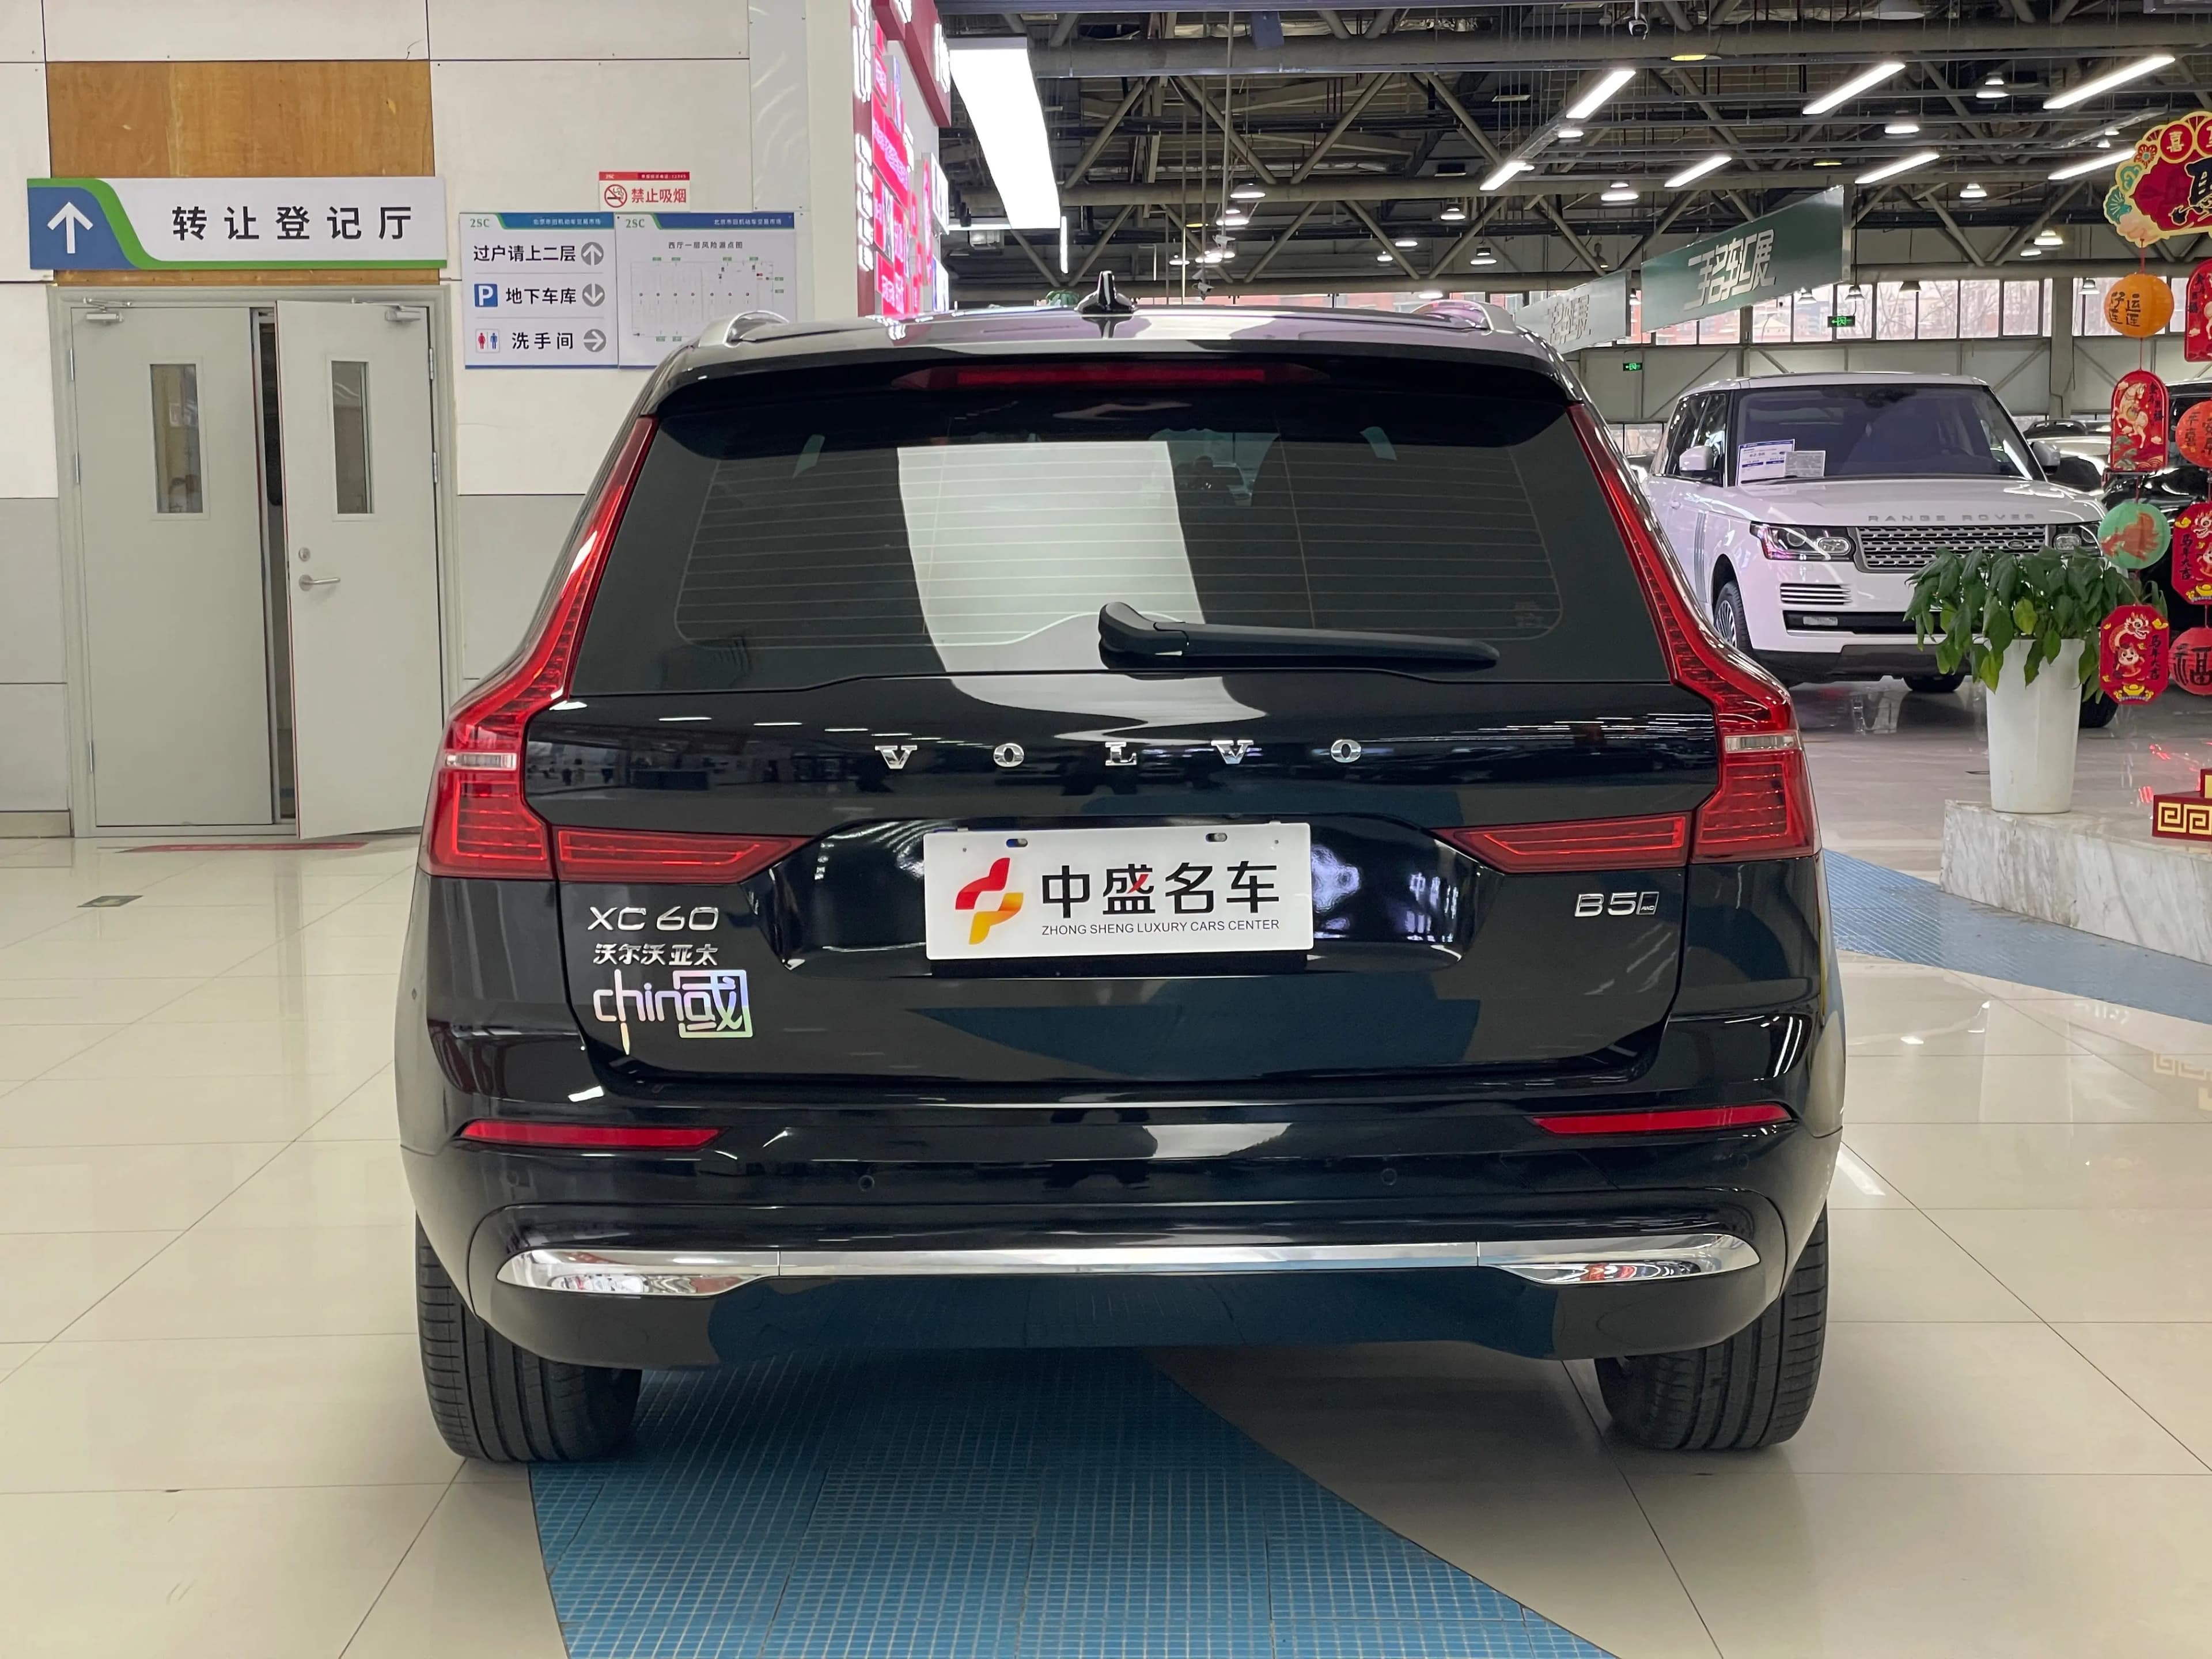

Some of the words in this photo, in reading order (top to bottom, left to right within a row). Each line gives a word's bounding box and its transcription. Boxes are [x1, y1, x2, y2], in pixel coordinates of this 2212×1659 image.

[631, 188, 686, 203] 禁止吸烟
[172, 206, 411, 241] 转让登记厅
[470, 218, 490, 228] 2SC
[626, 219, 645, 228] 2SC
[474, 245, 576, 262] 过户请上二层
[479, 285, 493, 306] P
[506, 287, 577, 305] 地下车库
[512, 332, 573, 350] 洗手间
[874, 738, 1362, 770] VOLVO
[1042, 861, 1279, 918] 中盛名车
[1042, 925, 1087, 935] ZHONG
[1090, 924, 1135, 934] SHENG
[1138, 922, 1188, 933] LUXURY
[1190, 922, 1225, 931] CARS
[1228, 920, 1279, 930] CENTER
[593, 943, 719, 966] 沃尔沃亚太
